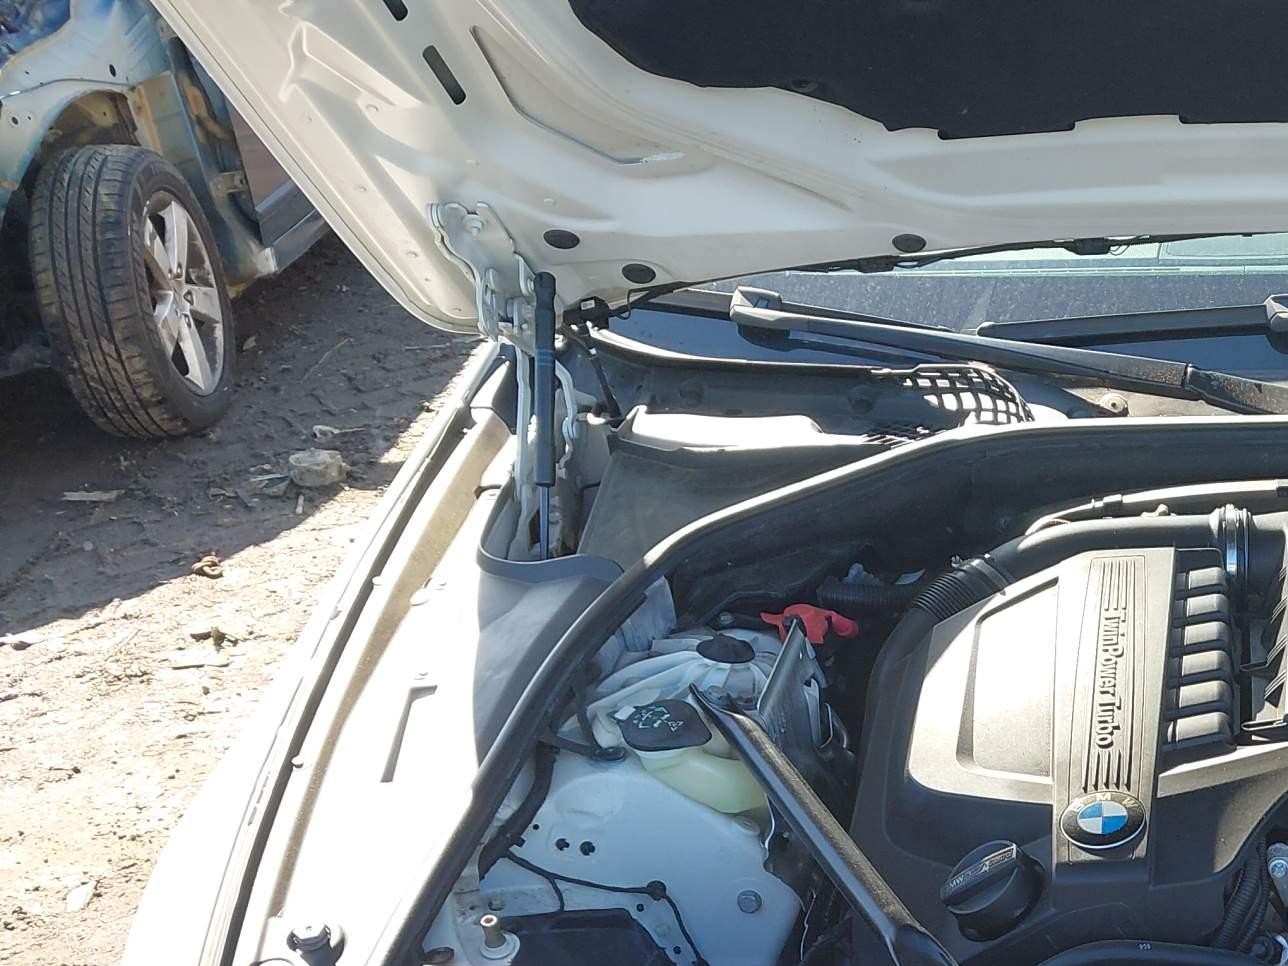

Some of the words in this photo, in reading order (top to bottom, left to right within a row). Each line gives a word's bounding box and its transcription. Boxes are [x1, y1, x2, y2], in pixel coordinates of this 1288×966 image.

[1099, 611, 1126, 696] TwinPower
[1096, 696, 1121, 750] Turbo
[1071, 792, 1138, 812] BMW
